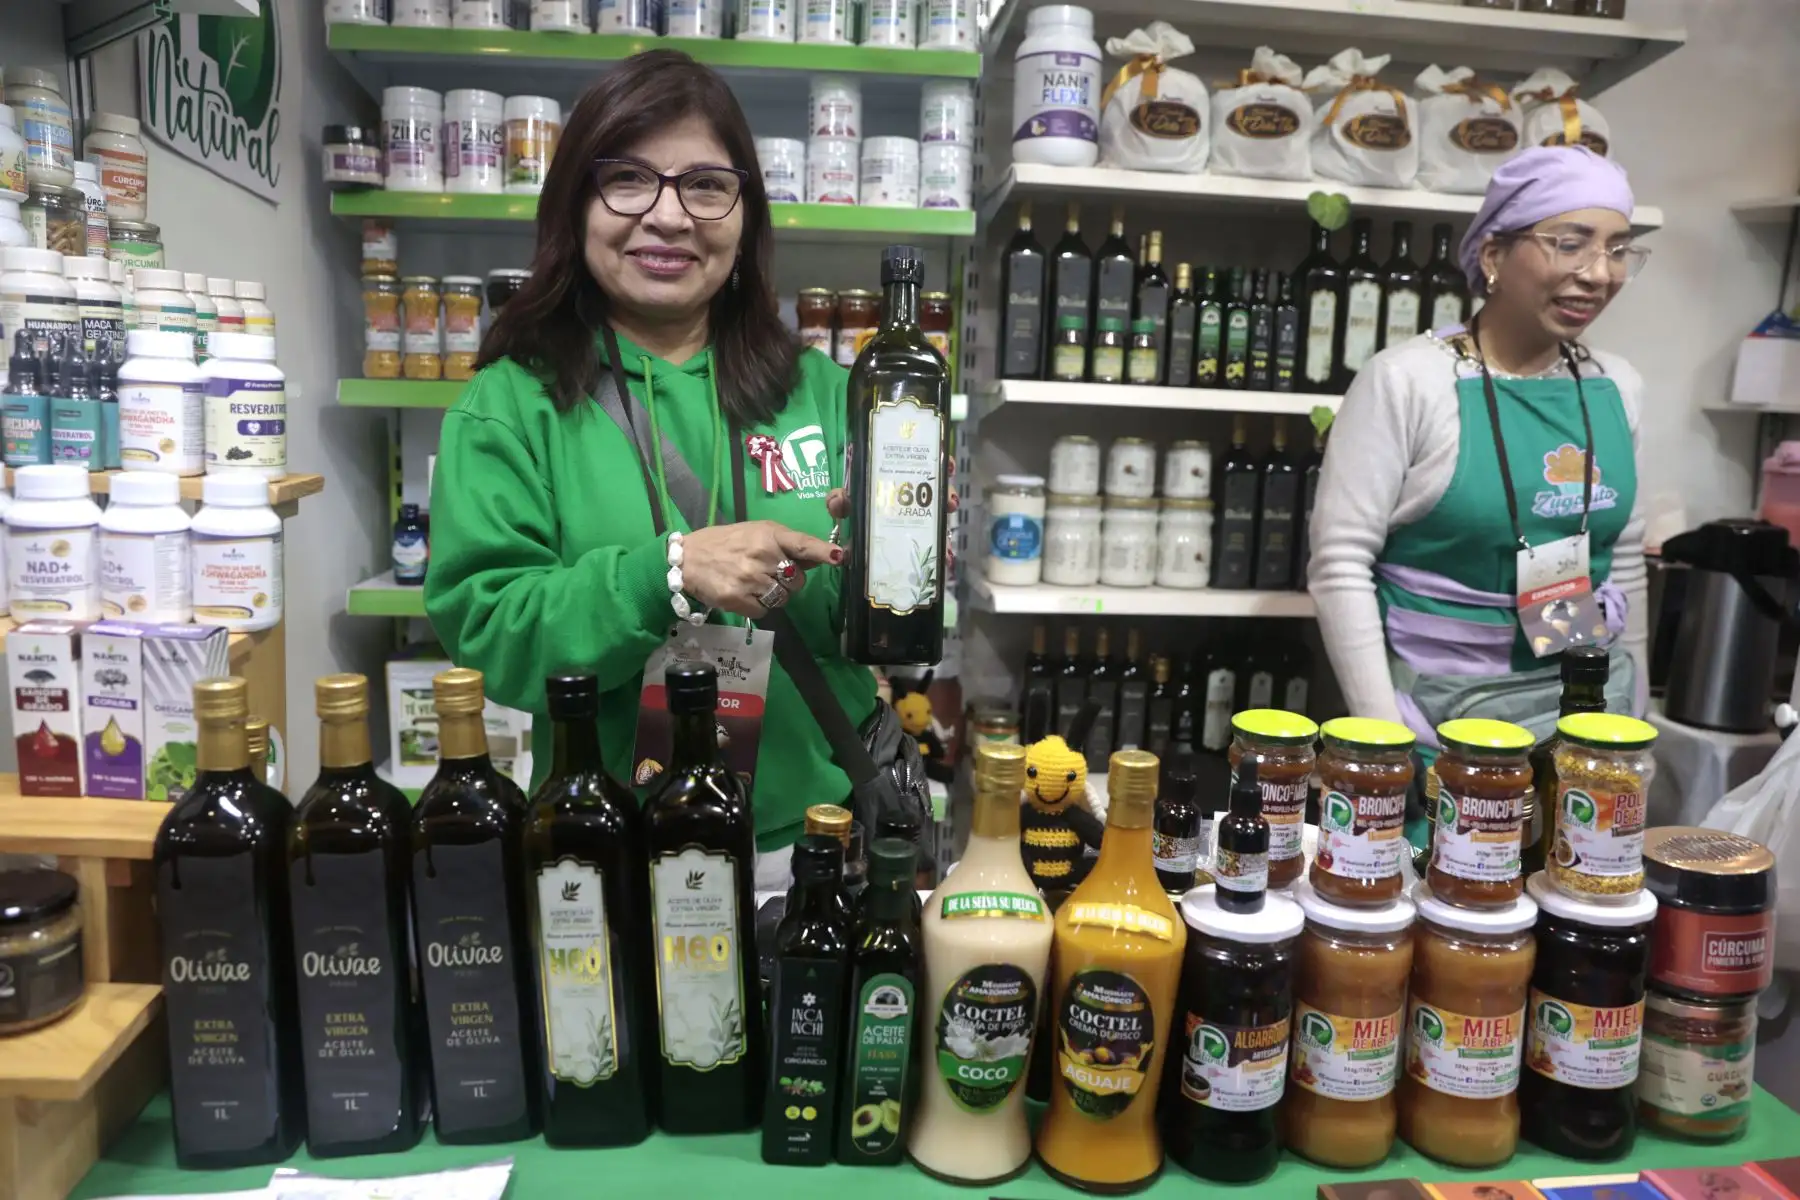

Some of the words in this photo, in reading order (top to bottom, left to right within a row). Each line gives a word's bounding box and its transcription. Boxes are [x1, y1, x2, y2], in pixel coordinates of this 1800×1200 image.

[391, 126, 432, 141] ZINC
[463, 127, 503, 143] ZINC
[84, 319, 112, 329] MACA
[26, 561, 72, 575] NAD+
[101, 561, 124, 574] AD+
[153, 703, 193, 713] OREGAN
[1616, 793, 1642, 810] POL
[1614, 810, 1632, 825] DE
[948, 898, 959, 911] DE
[960, 897, 971, 910] LA
[972, 896, 998, 909] SELVA
[1708, 936, 1766, 956] CÚRCUMA
[427, 941, 504, 968] Olivae
[170, 955, 252, 983] Olivae
[302, 950, 382, 978] Olivae
[451, 1002, 489, 1014] EXTRA
[791, 1008, 823, 1022] INCA
[953, 1002, 1027, 1023] COCTEL
[325, 1013, 365, 1024] EXTRA
[450, 1013, 494, 1026] VIRGEN
[1069, 1003, 1143, 1031] COCTEL
[1594, 1008, 1639, 1029] MIEL
[194, 1020, 235, 1031] EXTRA
[324, 1025, 369, 1037] VIRGEN
[790, 1021, 824, 1035] INCHI
[863, 1025, 905, 1036] ACEITE
[987, 1021, 999, 1031] DE
[1068, 1018, 1098, 1035] CREMA
[1354, 1018, 1397, 1039] MIEL
[1463, 1017, 1513, 1038] MIEL
[193, 1033, 239, 1043] VIRGEN
[450, 1028, 490, 1039] ACEITE
[862, 1035, 876, 1045] DE
[877, 1035, 905, 1045] PALTA
[1592, 1027, 1609, 1039] DE
[323, 1040, 364, 1050] ACEITE
[446, 1037, 461, 1048] DE
[466, 1034, 501, 1047] OLIVA
[1352, 1037, 1369, 1049] DE
[1462, 1036, 1478, 1048] DE
[318, 1049, 335, 1058] DE
[338, 1047, 376, 1058] OLIVA
[188, 1056, 204, 1065] DE
[208, 1056, 246, 1065] OLIVA
[957, 1064, 1009, 1081] COCO
[1065, 1064, 1132, 1090] AGUAJE
[473, 1085, 488, 1099] 1L
[344, 1098, 360, 1111] 1L
[214, 1107, 229, 1120] 1L
